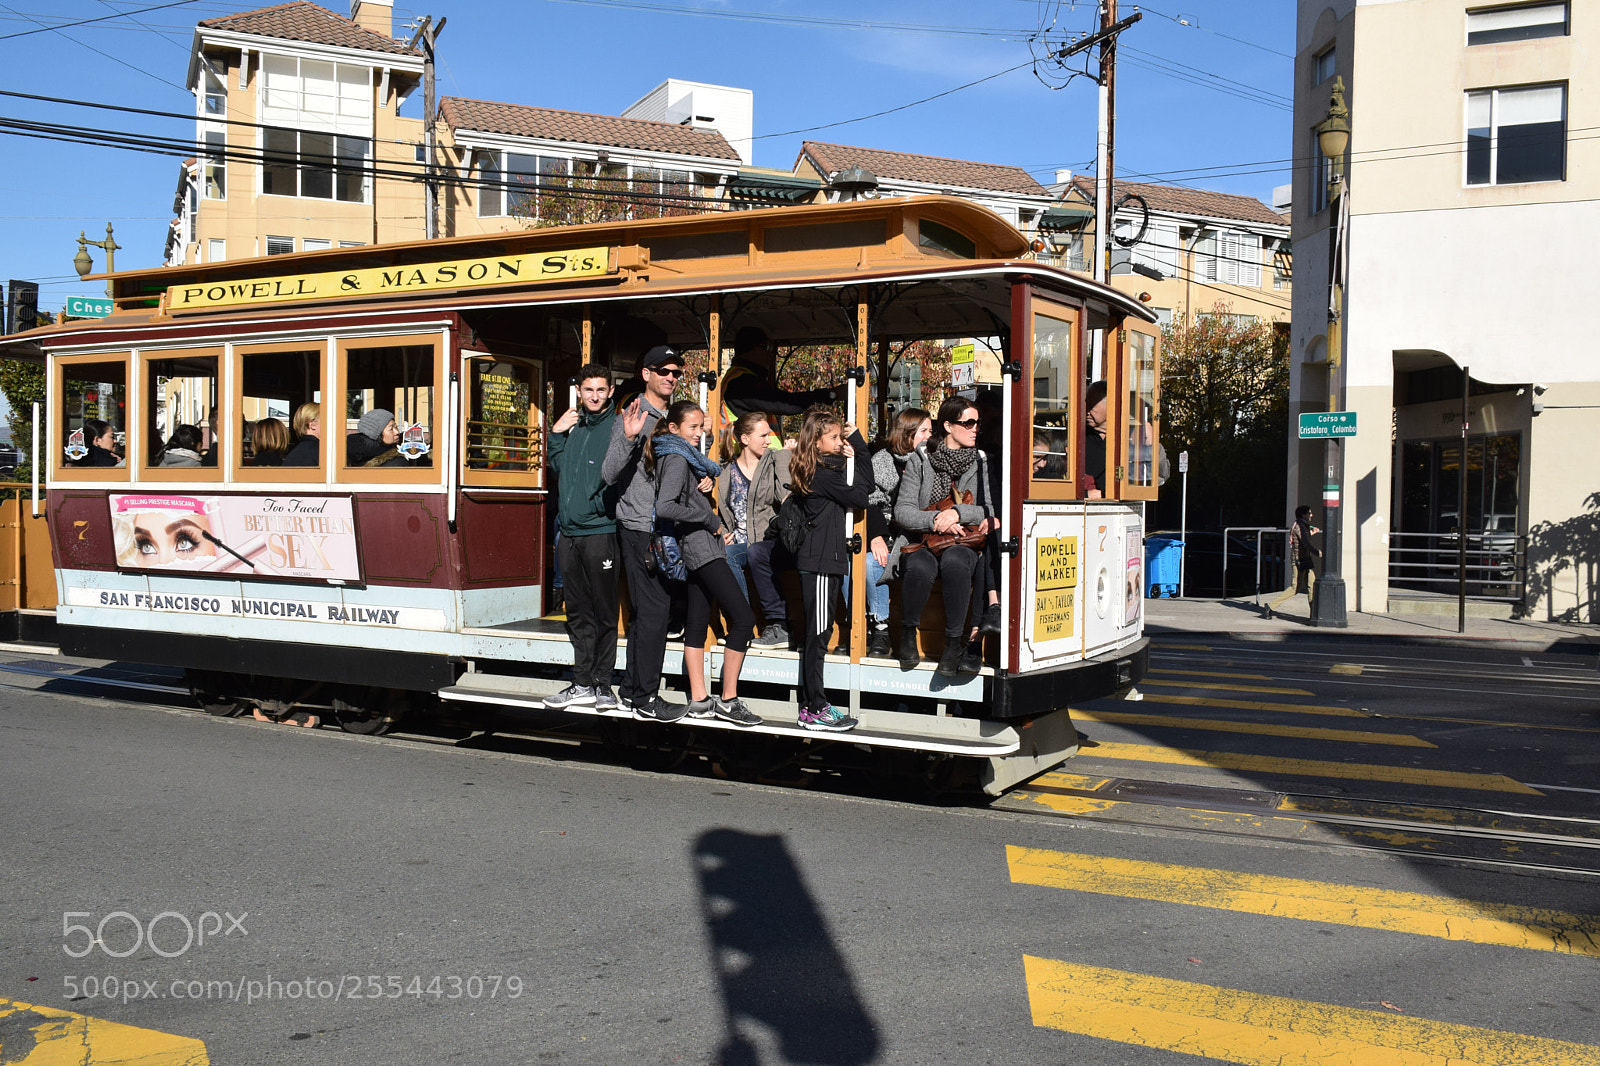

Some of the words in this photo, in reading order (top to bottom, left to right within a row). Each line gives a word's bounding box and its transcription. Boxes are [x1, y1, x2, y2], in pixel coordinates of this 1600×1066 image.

[184, 279, 317, 303] POWELL
[340, 274, 361, 291] &
[380, 259, 522, 288] MASON
[73, 301, 112, 314] Ches
[1300, 426, 1328, 434] Cristoforo
[1332, 425, 1357, 434] Colombo
[171, 499, 195, 507] MASCARA
[263, 498, 284, 513] Too
[288, 499, 328, 514] Faced
[73, 520, 90, 540] 7
[243, 514, 305, 533] BETTER
[306, 516, 354, 535] THAN
[1098, 525, 1107, 551] 7
[268, 533, 335, 571] SEX
[1040, 543, 1076, 556] POWELL
[1050, 558, 1068, 567] AND
[1040, 567, 1076, 581] MARKET
[100, 591, 129, 606] SAN
[134, 594, 221, 613] FRANCISCO
[327, 606, 400, 624] RAILWAY
[1036, 598, 1047, 611] BAY
[1055, 594, 1074, 609] TAYLOR
[1039, 611, 1070, 624] FISHERMANS
[1046, 622, 1063, 634] WHARF
[742, 668, 759, 676] TWO
[869, 679, 888, 688] TWO
